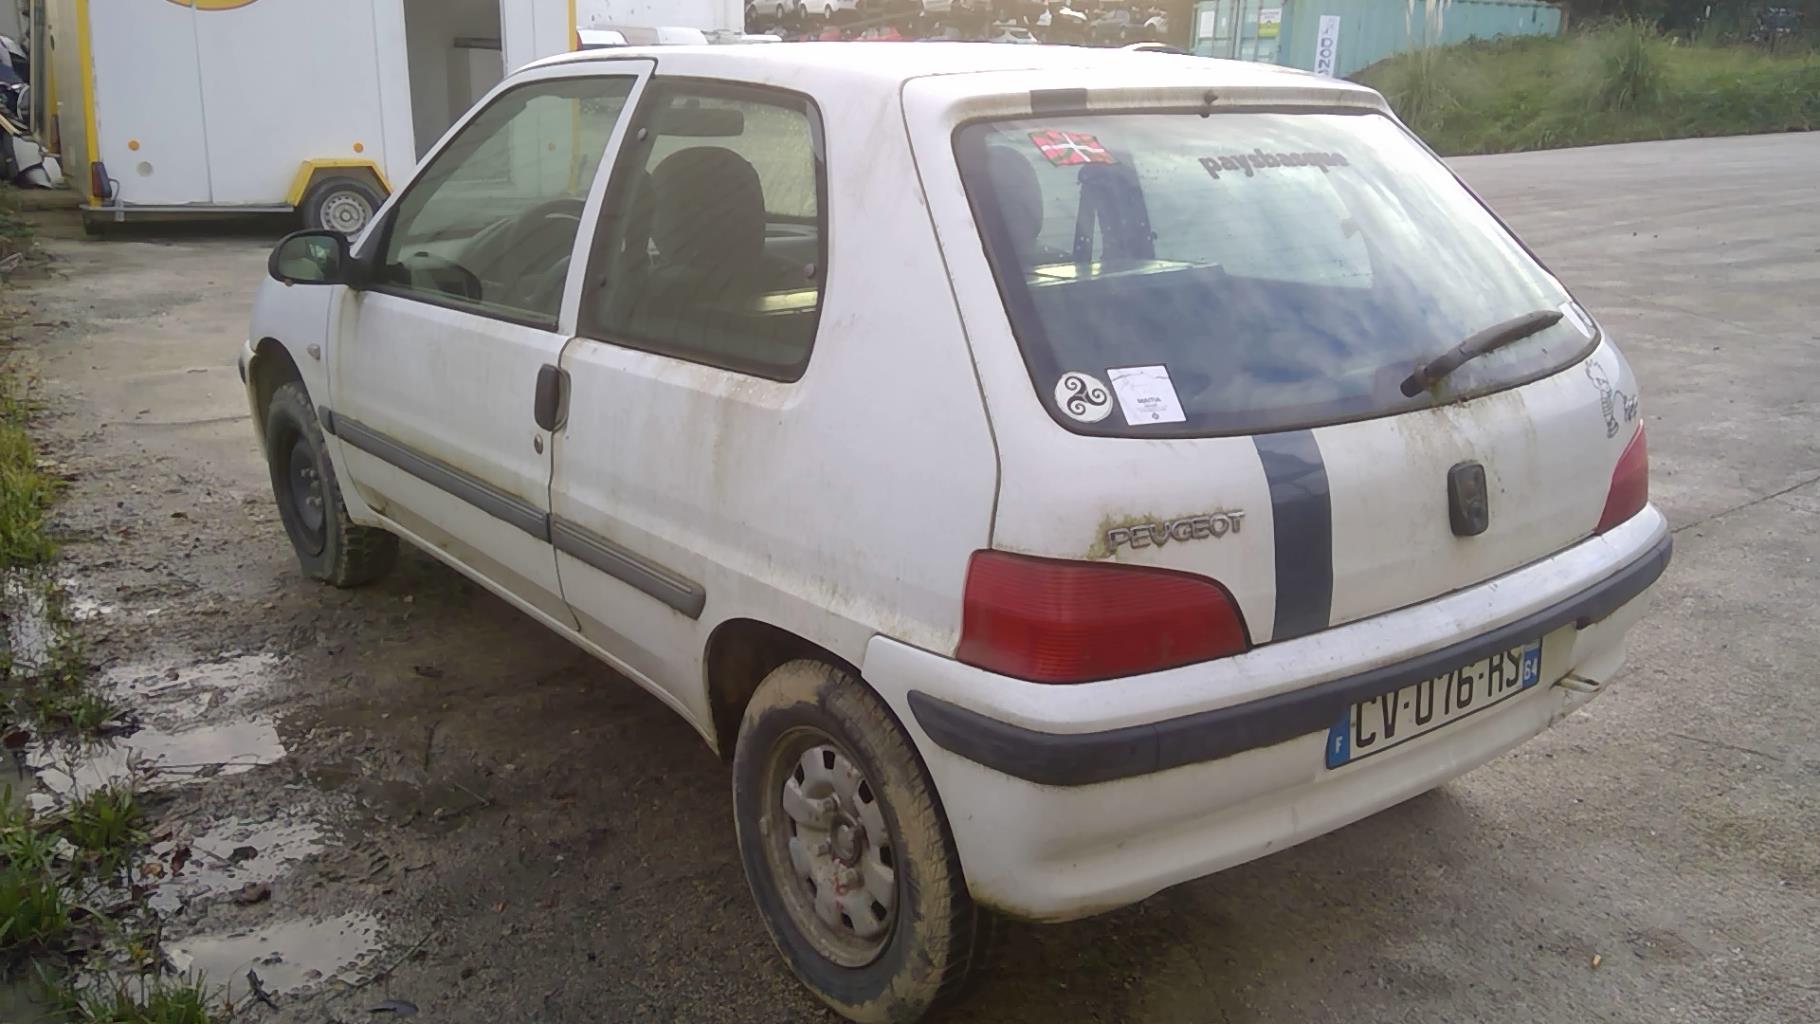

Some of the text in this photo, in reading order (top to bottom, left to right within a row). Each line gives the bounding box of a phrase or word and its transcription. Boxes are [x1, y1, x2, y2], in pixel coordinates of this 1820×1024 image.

[1108, 509, 1246, 553] PEUGEOT
[1335, 650, 1538, 753] F CV-076-RS 64
